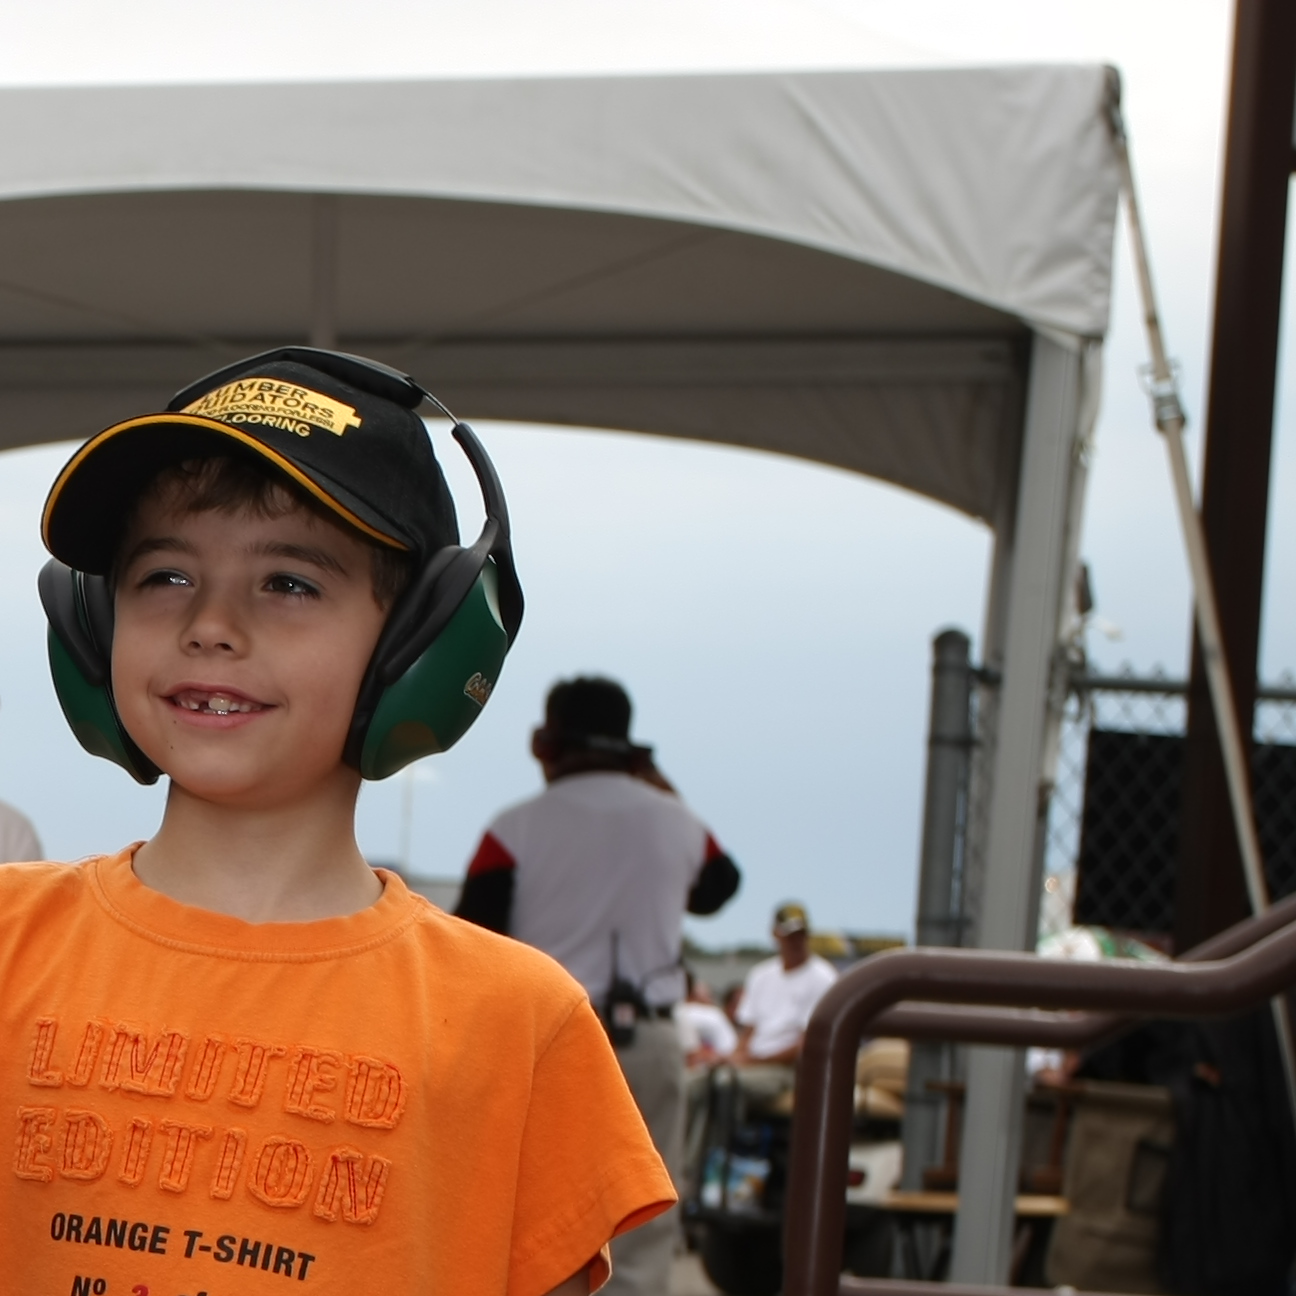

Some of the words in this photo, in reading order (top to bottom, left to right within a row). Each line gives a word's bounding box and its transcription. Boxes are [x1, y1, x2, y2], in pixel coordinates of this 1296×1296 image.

[215, 414, 312, 438] LOORING
[27, 1016, 408, 1130] LIMITED
[14, 1107, 392, 1225] EDITION
[50, 1212, 170, 1255] ORANGE
[183, 1230, 316, 1281] T-SHIRT
